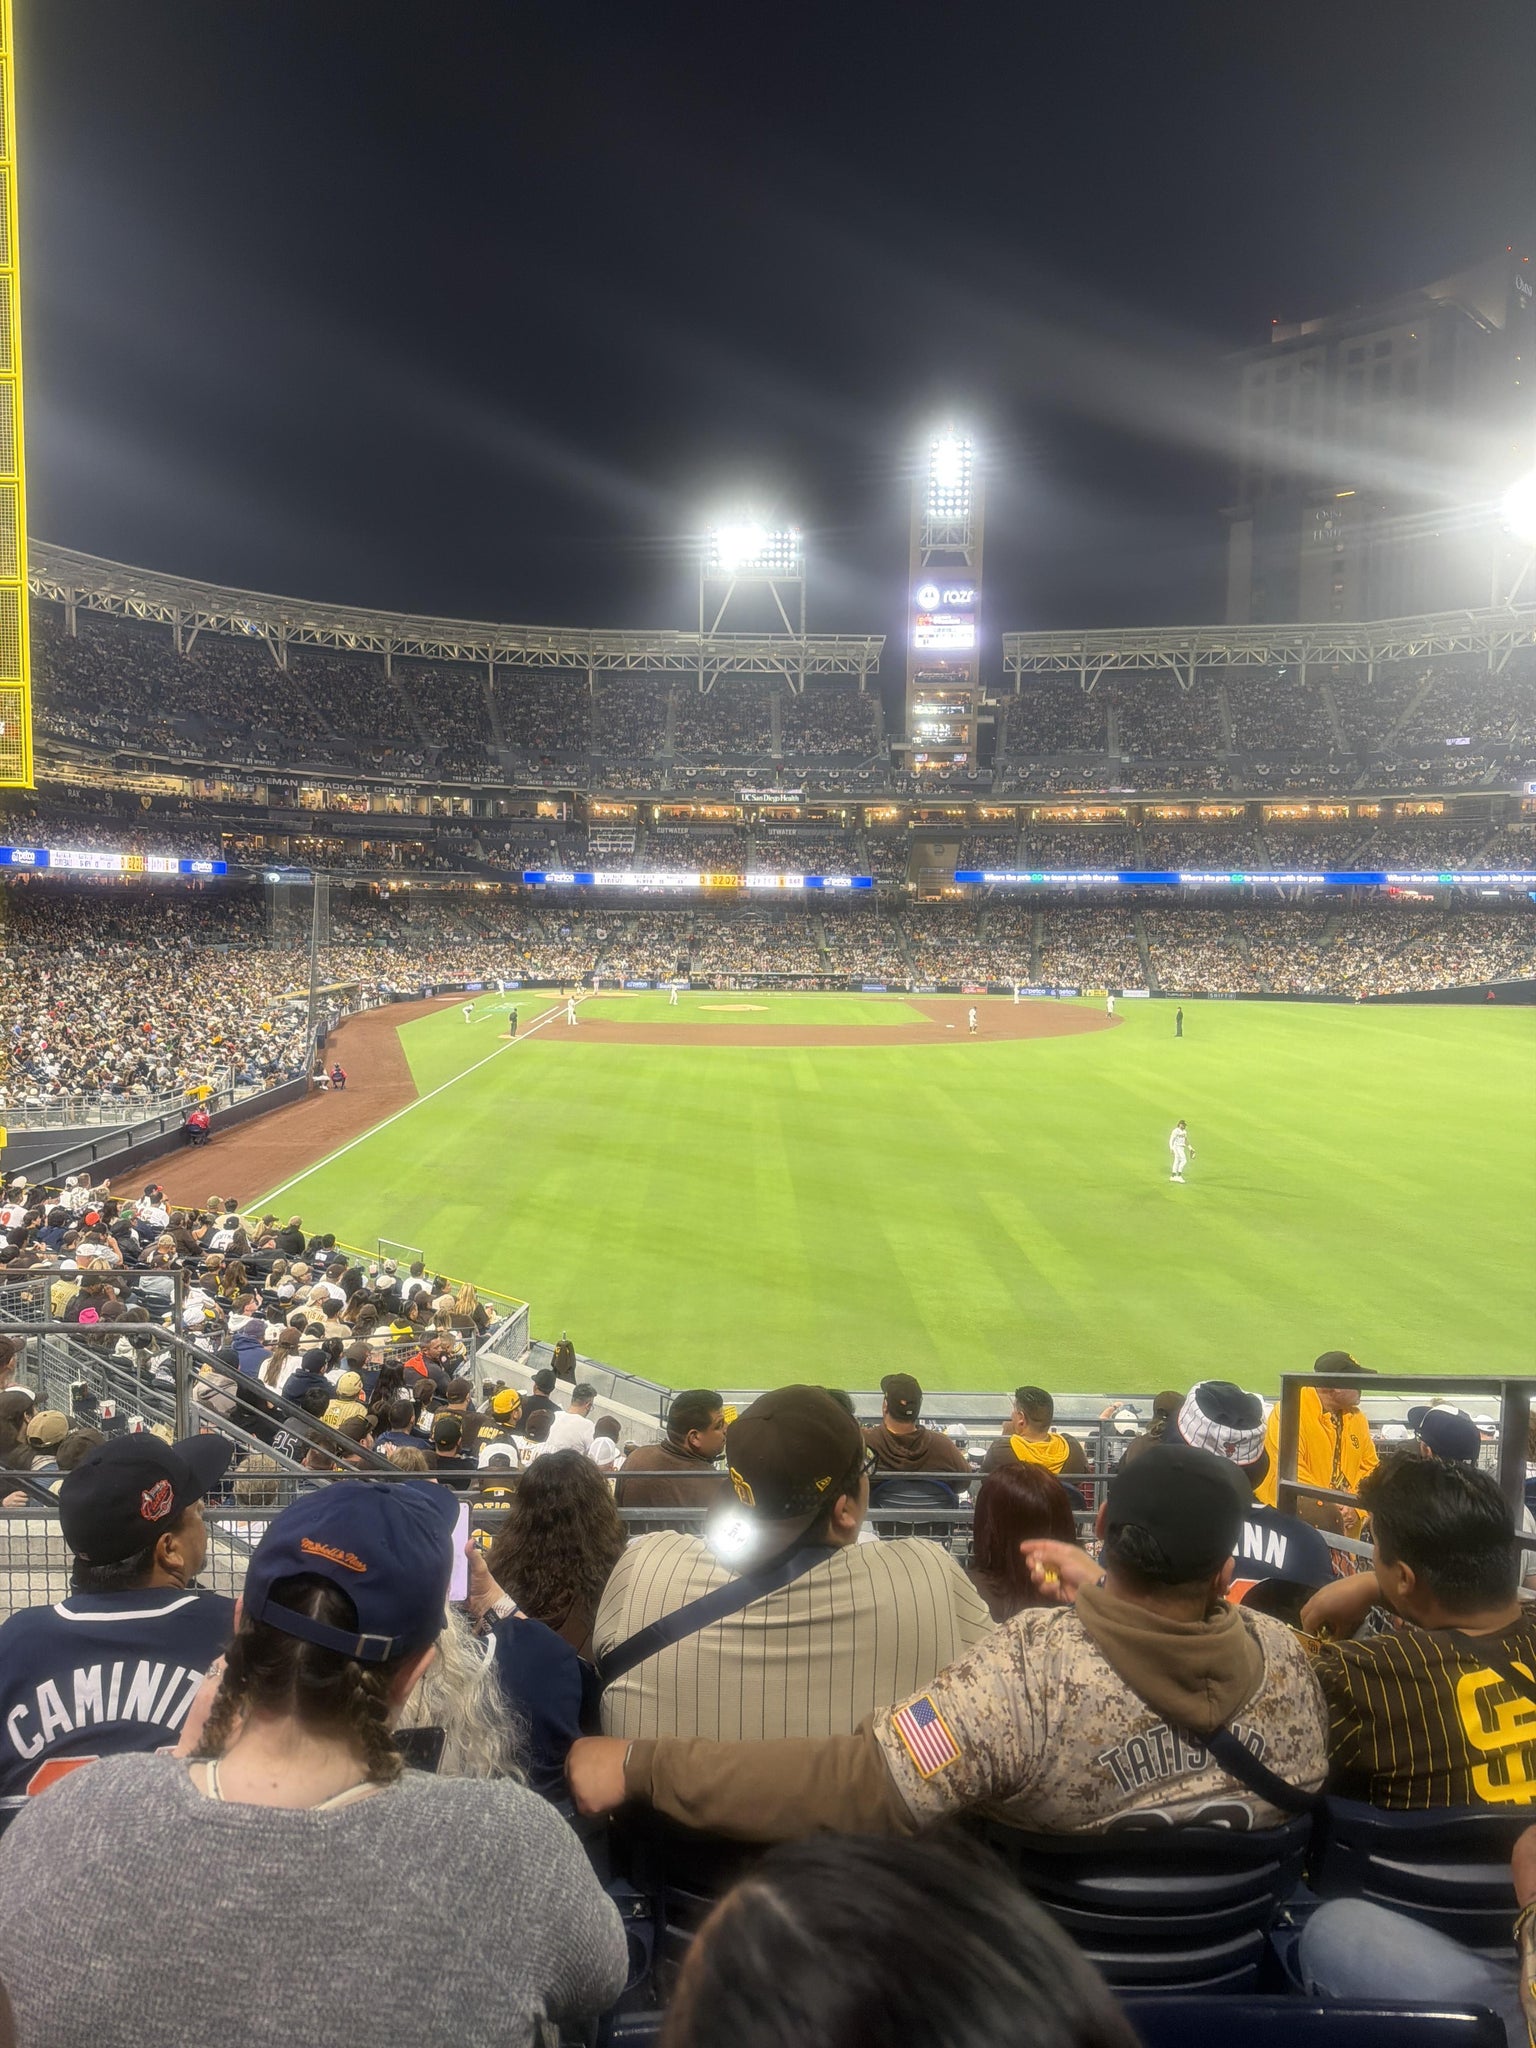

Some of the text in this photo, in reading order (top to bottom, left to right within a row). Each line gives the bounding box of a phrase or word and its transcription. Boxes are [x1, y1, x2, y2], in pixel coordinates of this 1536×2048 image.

[944, 590, 975, 604] razr
[208, 772, 417, 795] JERRY COLEMAN BROADCAST CENTER
[741, 794, 800, 803] UC San Diego Health
[1068, 874, 1077, 882] up
[1270, 874, 1279, 882] up
[1481, 874, 1491, 882] up
[7, 1660, 206, 1759] CAMINIT
[1098, 1725, 1209, 1795] TATIS
